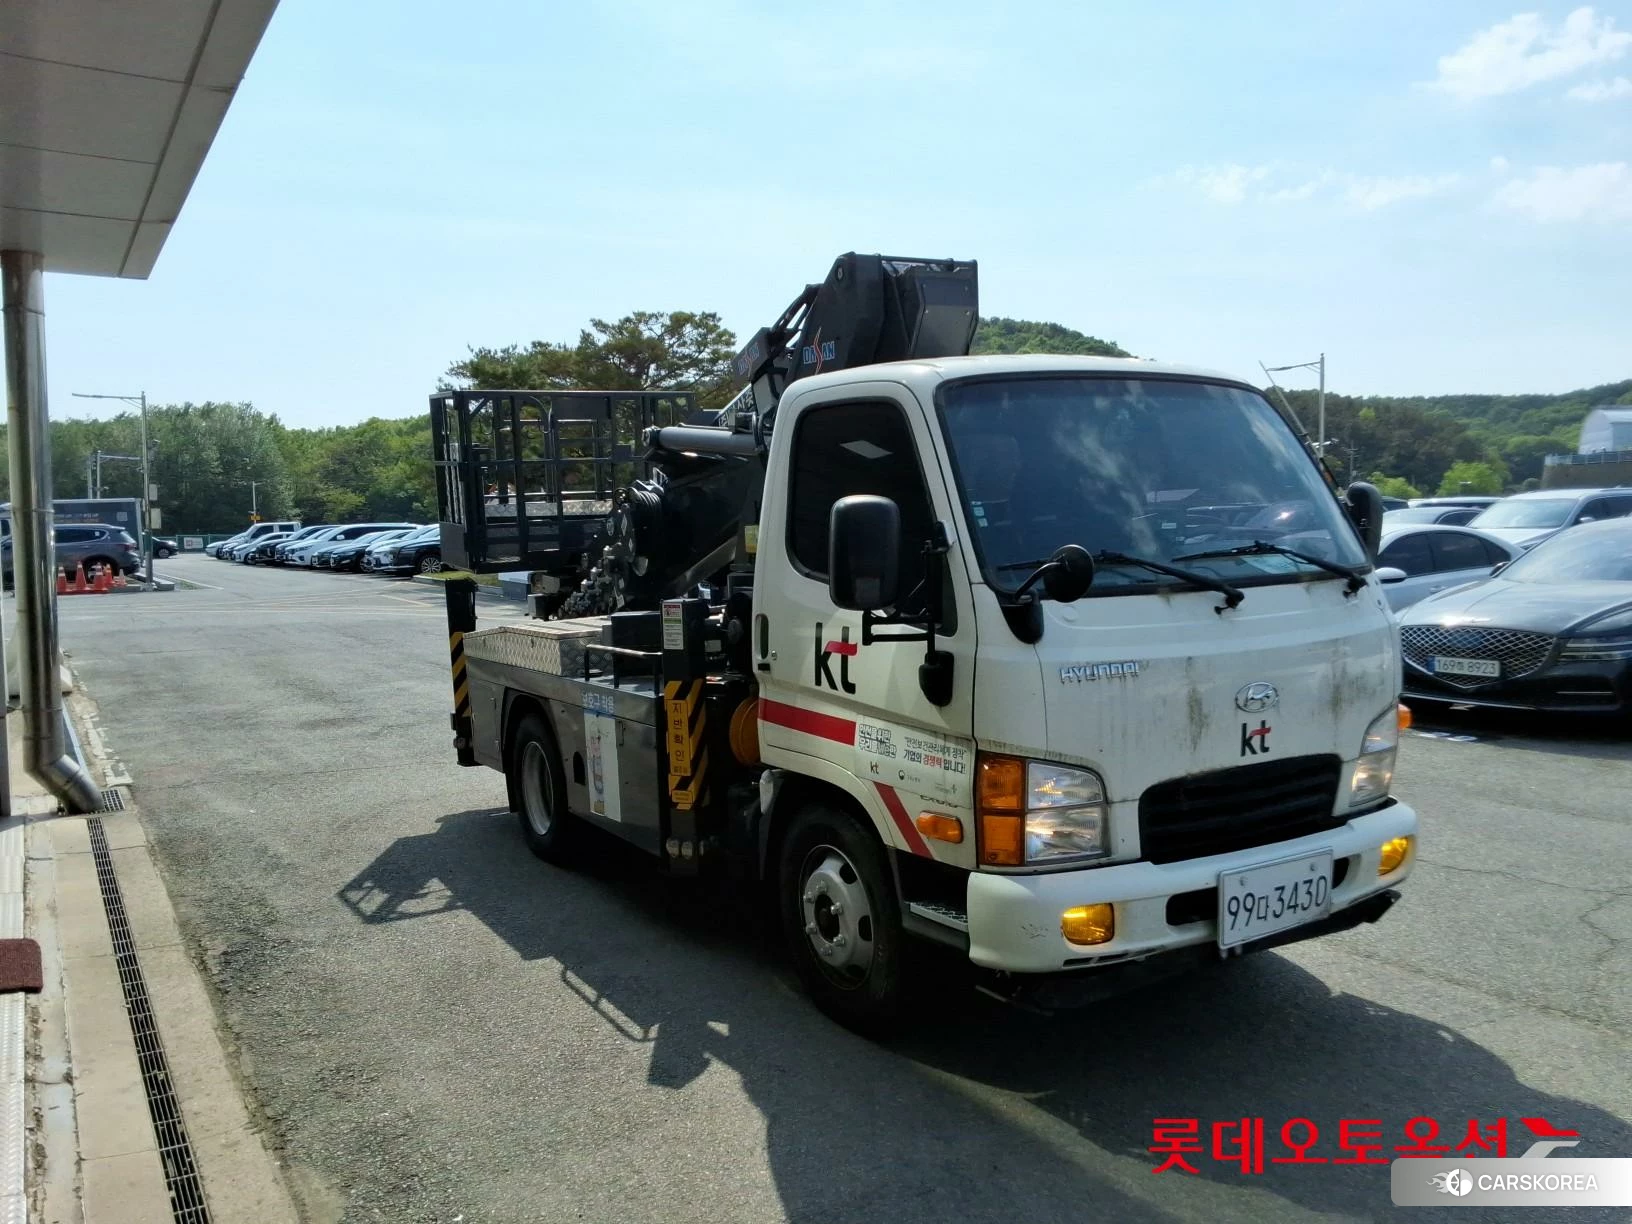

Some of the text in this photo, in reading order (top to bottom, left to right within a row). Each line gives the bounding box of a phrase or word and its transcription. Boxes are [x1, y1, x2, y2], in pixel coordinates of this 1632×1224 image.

[814, 621, 858, 695] kt
[1059, 661, 1139, 683] HYUNDAI
[1240, 720, 1271, 757] kt
[870, 761, 879, 775] kt
